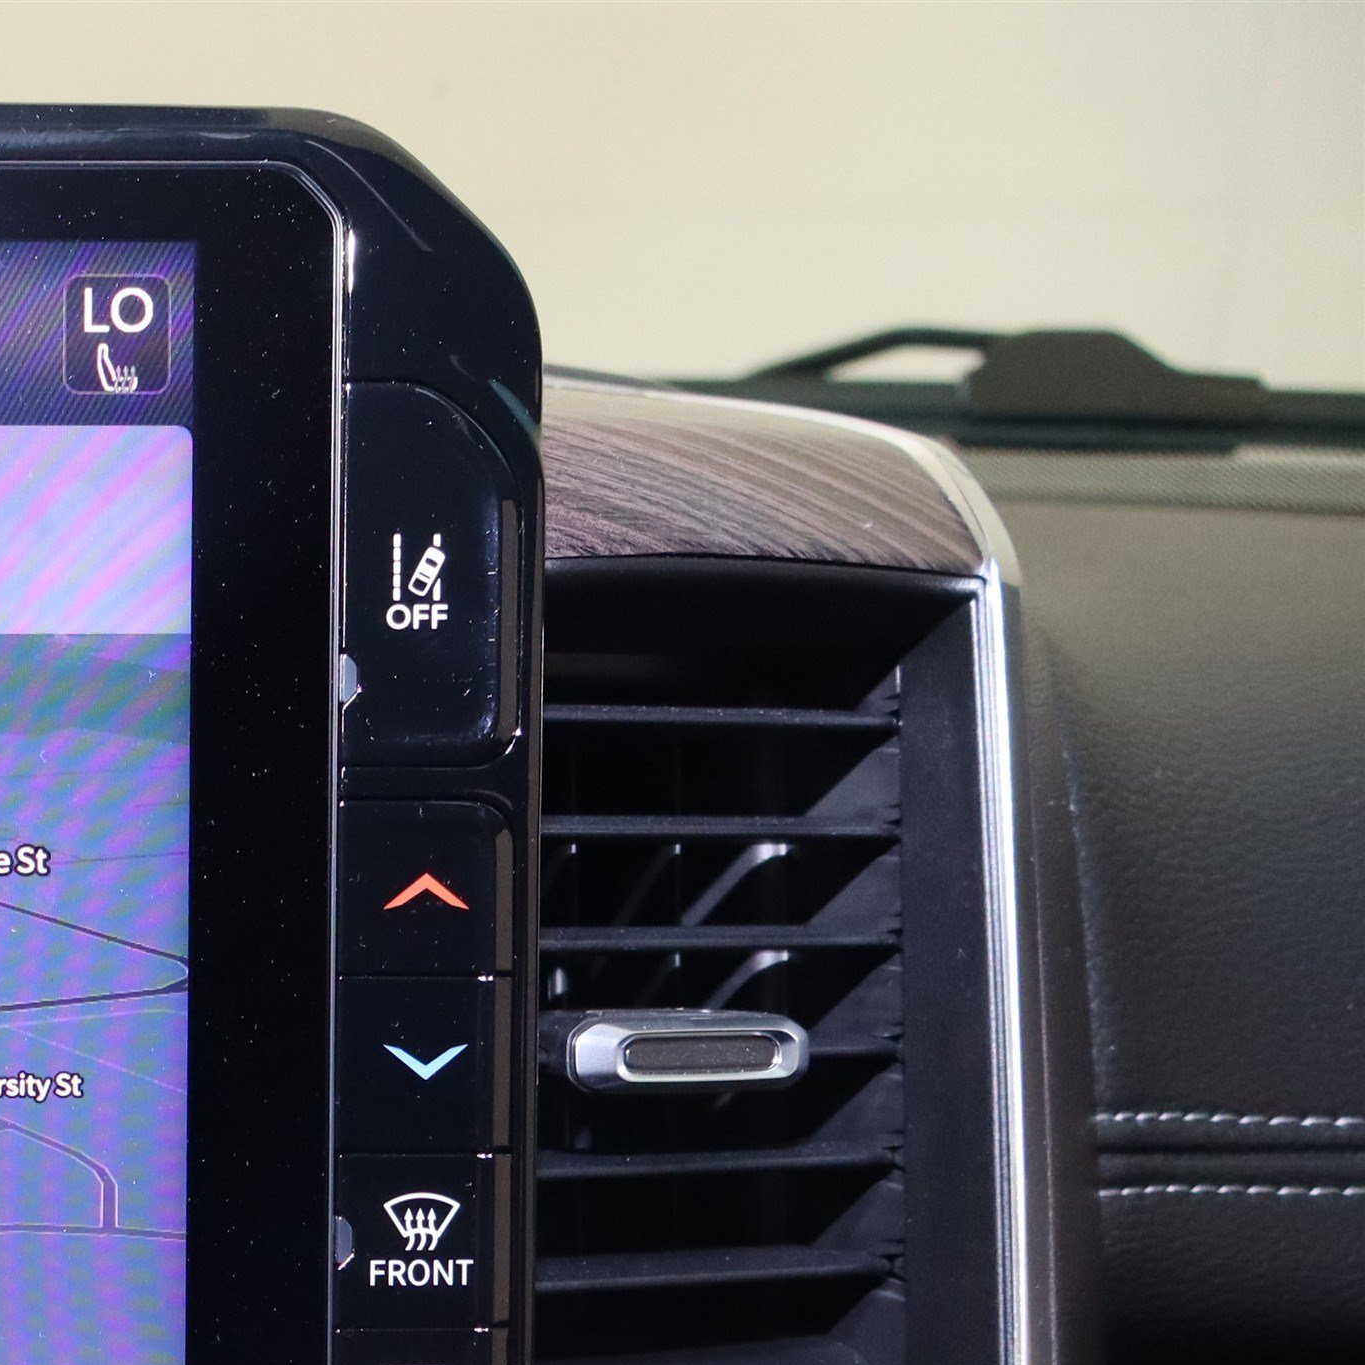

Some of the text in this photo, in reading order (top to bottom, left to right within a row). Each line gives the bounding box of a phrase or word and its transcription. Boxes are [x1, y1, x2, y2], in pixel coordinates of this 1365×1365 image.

[81, 286, 154, 334] LO
[386, 604, 448, 631] OFF
[15, 845, 49, 876] St
[54, 1072, 82, 1098] St
[369, 1259, 474, 1286] FRONT
